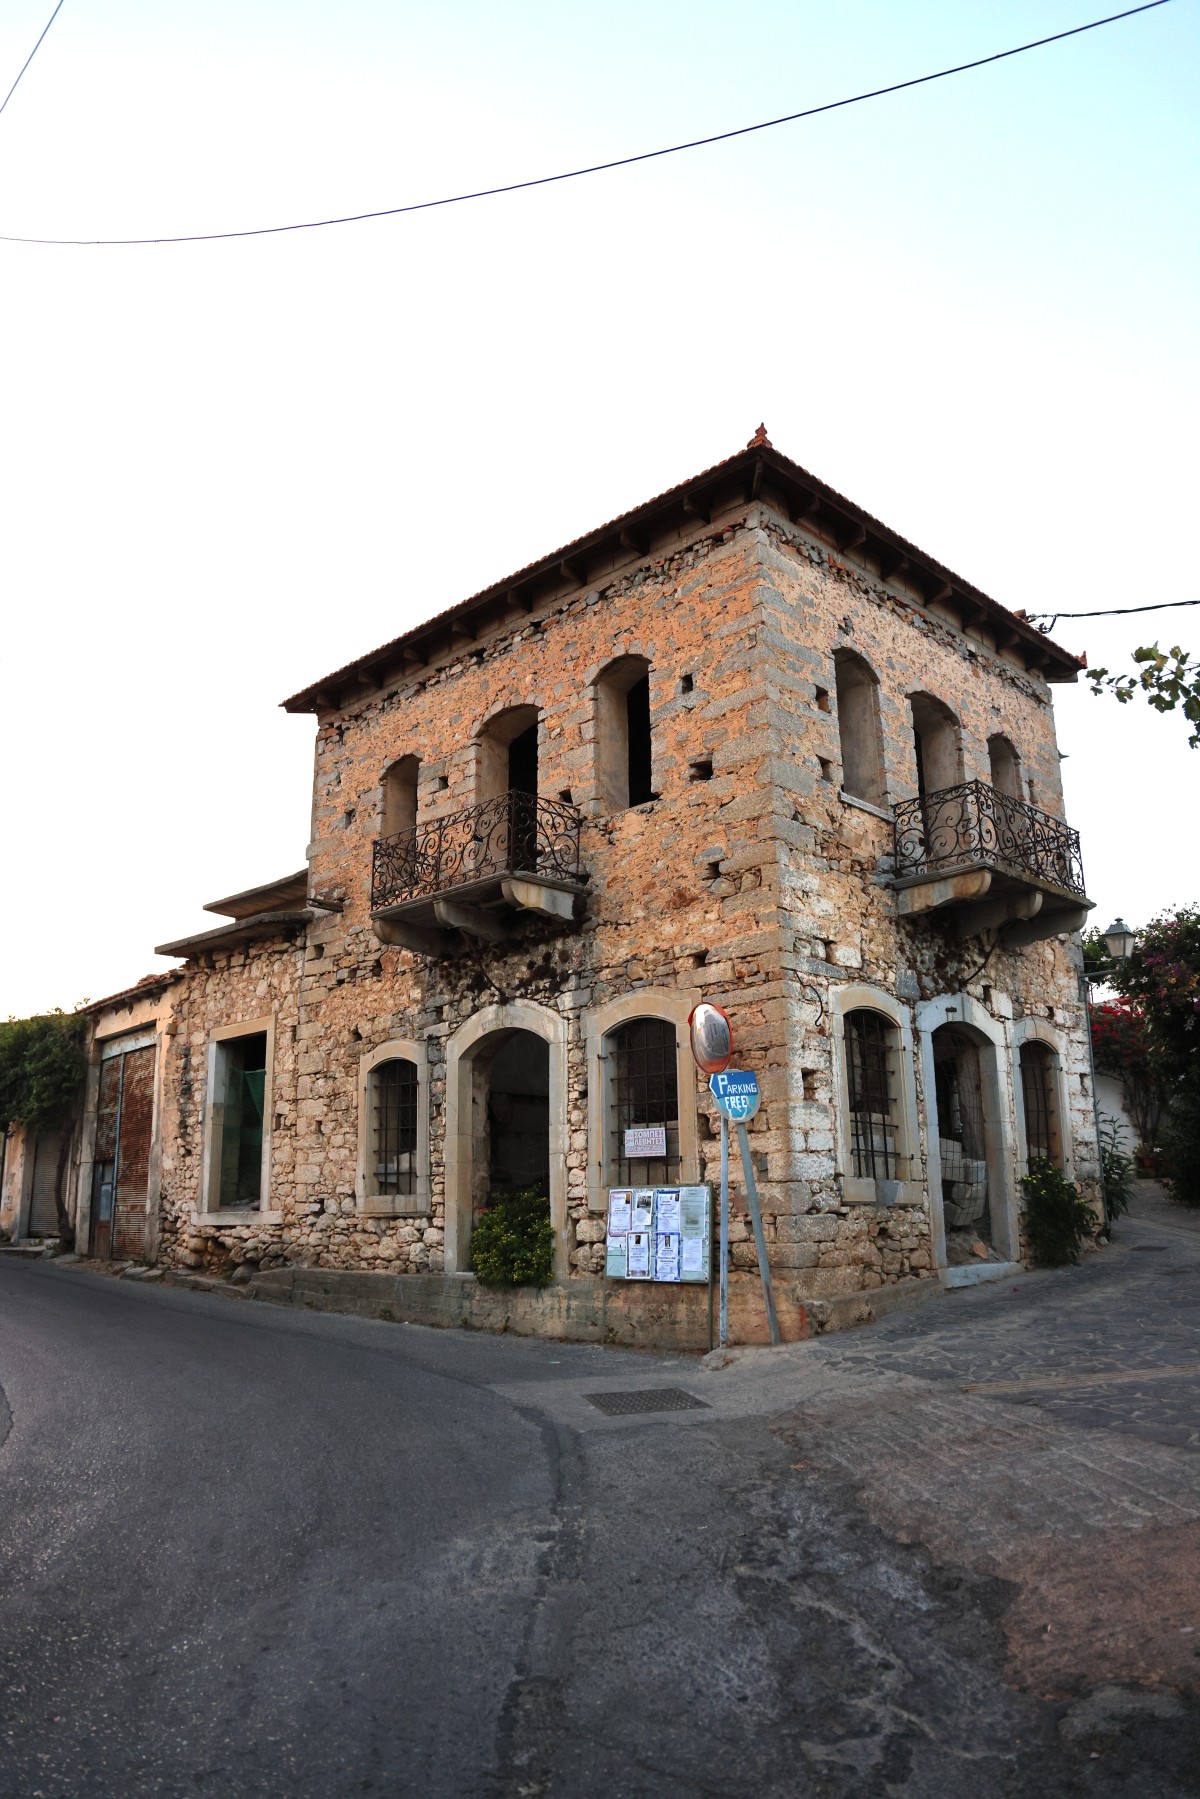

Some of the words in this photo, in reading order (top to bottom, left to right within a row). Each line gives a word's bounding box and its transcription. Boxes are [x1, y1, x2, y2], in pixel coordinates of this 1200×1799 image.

[717, 1074, 758, 1095] PARKING
[724, 1095, 748, 1110] FREE
[634, 1130, 663, 1138] ΣΟΜΠΕΣ
